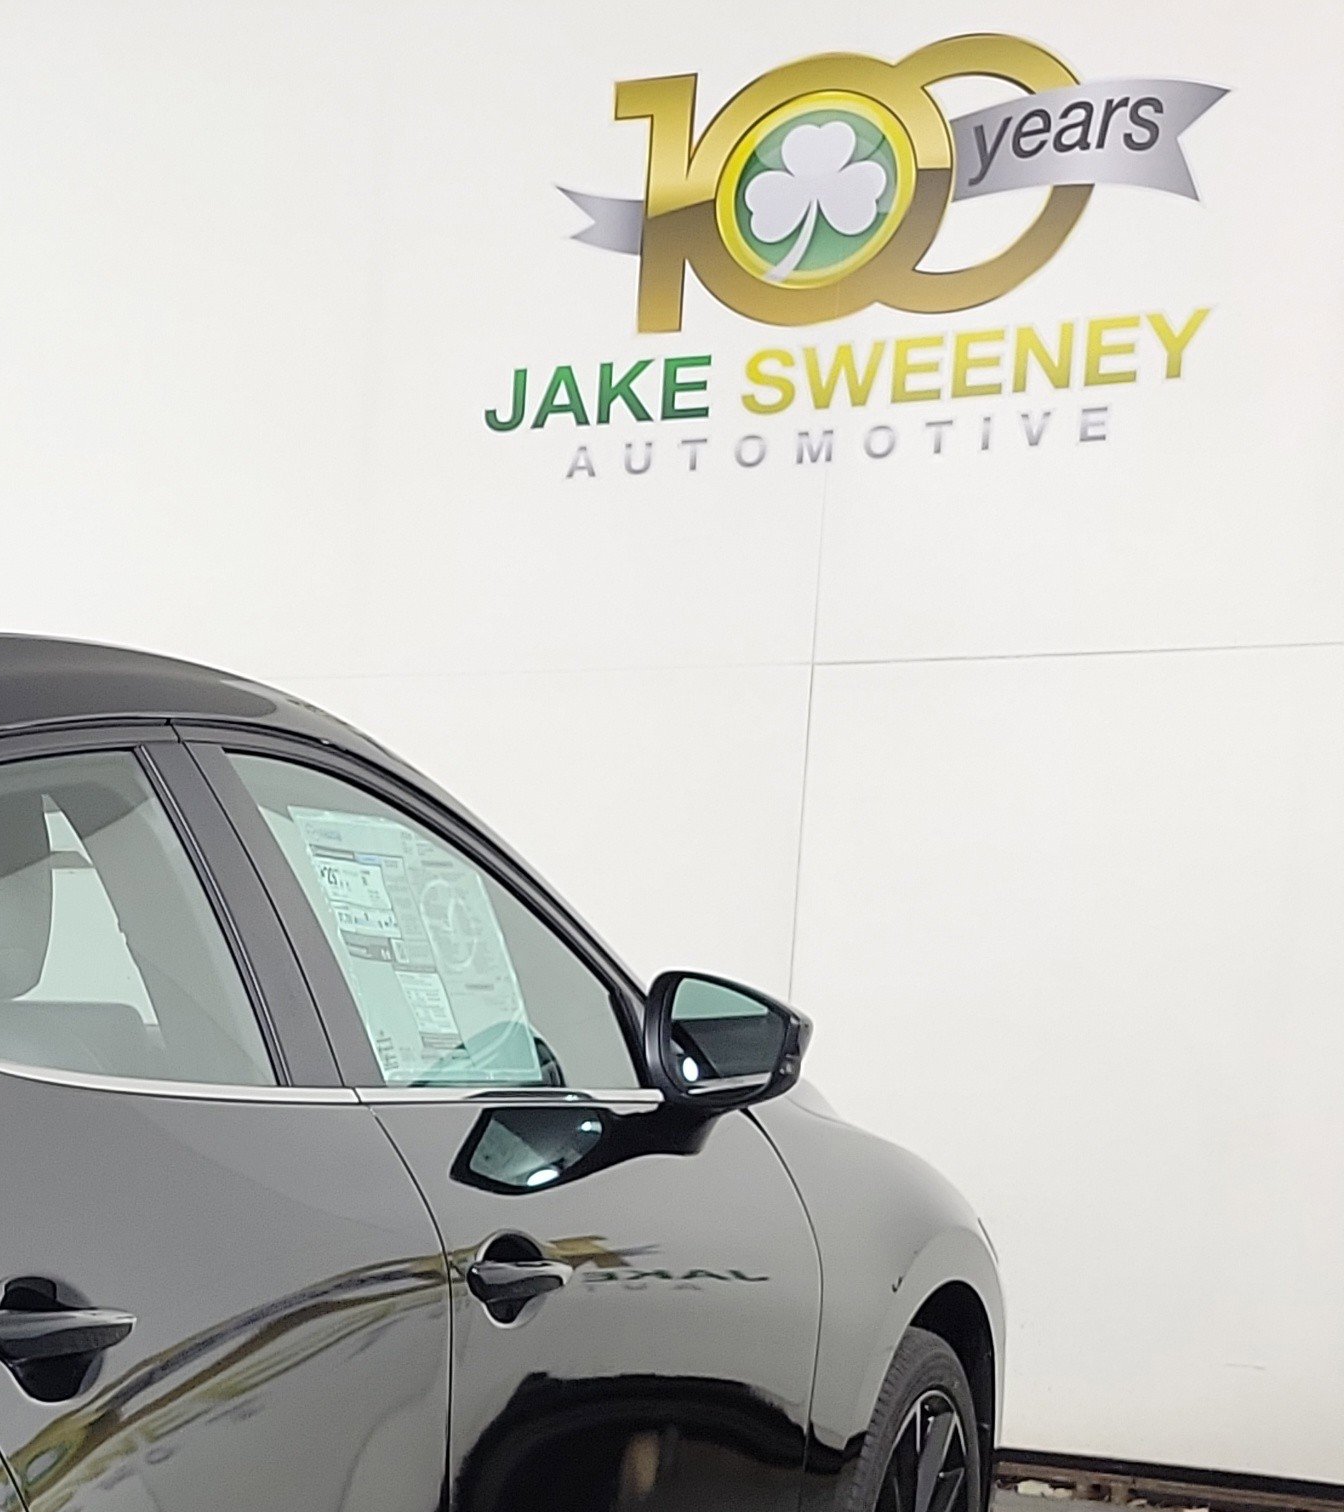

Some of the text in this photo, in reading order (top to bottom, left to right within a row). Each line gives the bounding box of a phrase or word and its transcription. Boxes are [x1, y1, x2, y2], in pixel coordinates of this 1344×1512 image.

[613, 33, 1164, 334] 100 years
[485, 308, 1211, 432] JAKE SWEENEY
[566, 407, 1109, 479] AUTOMOTIVE
